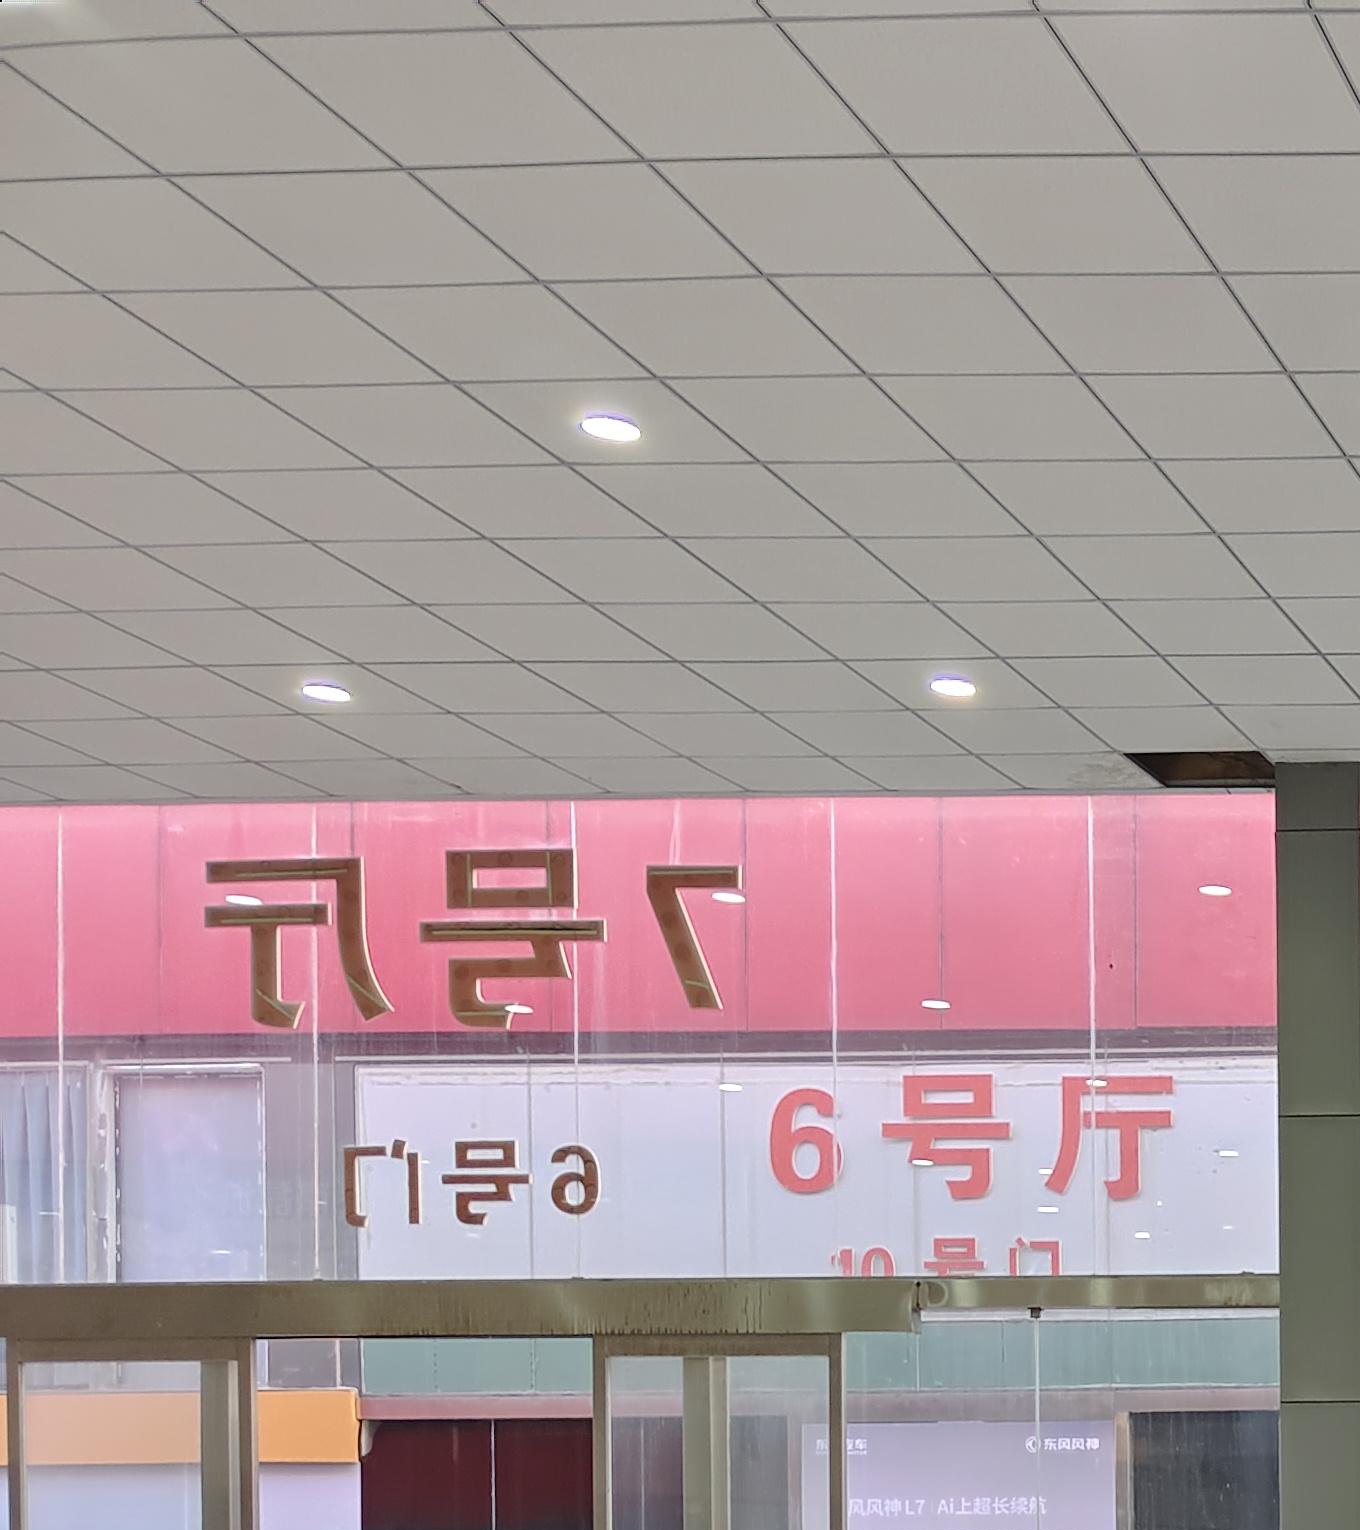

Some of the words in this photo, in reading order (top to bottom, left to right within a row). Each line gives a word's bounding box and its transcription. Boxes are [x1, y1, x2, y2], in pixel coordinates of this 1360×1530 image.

[769, 1073, 1176, 1202] 6号厅
[1043, 1437, 1100, 1451] 东风风神
